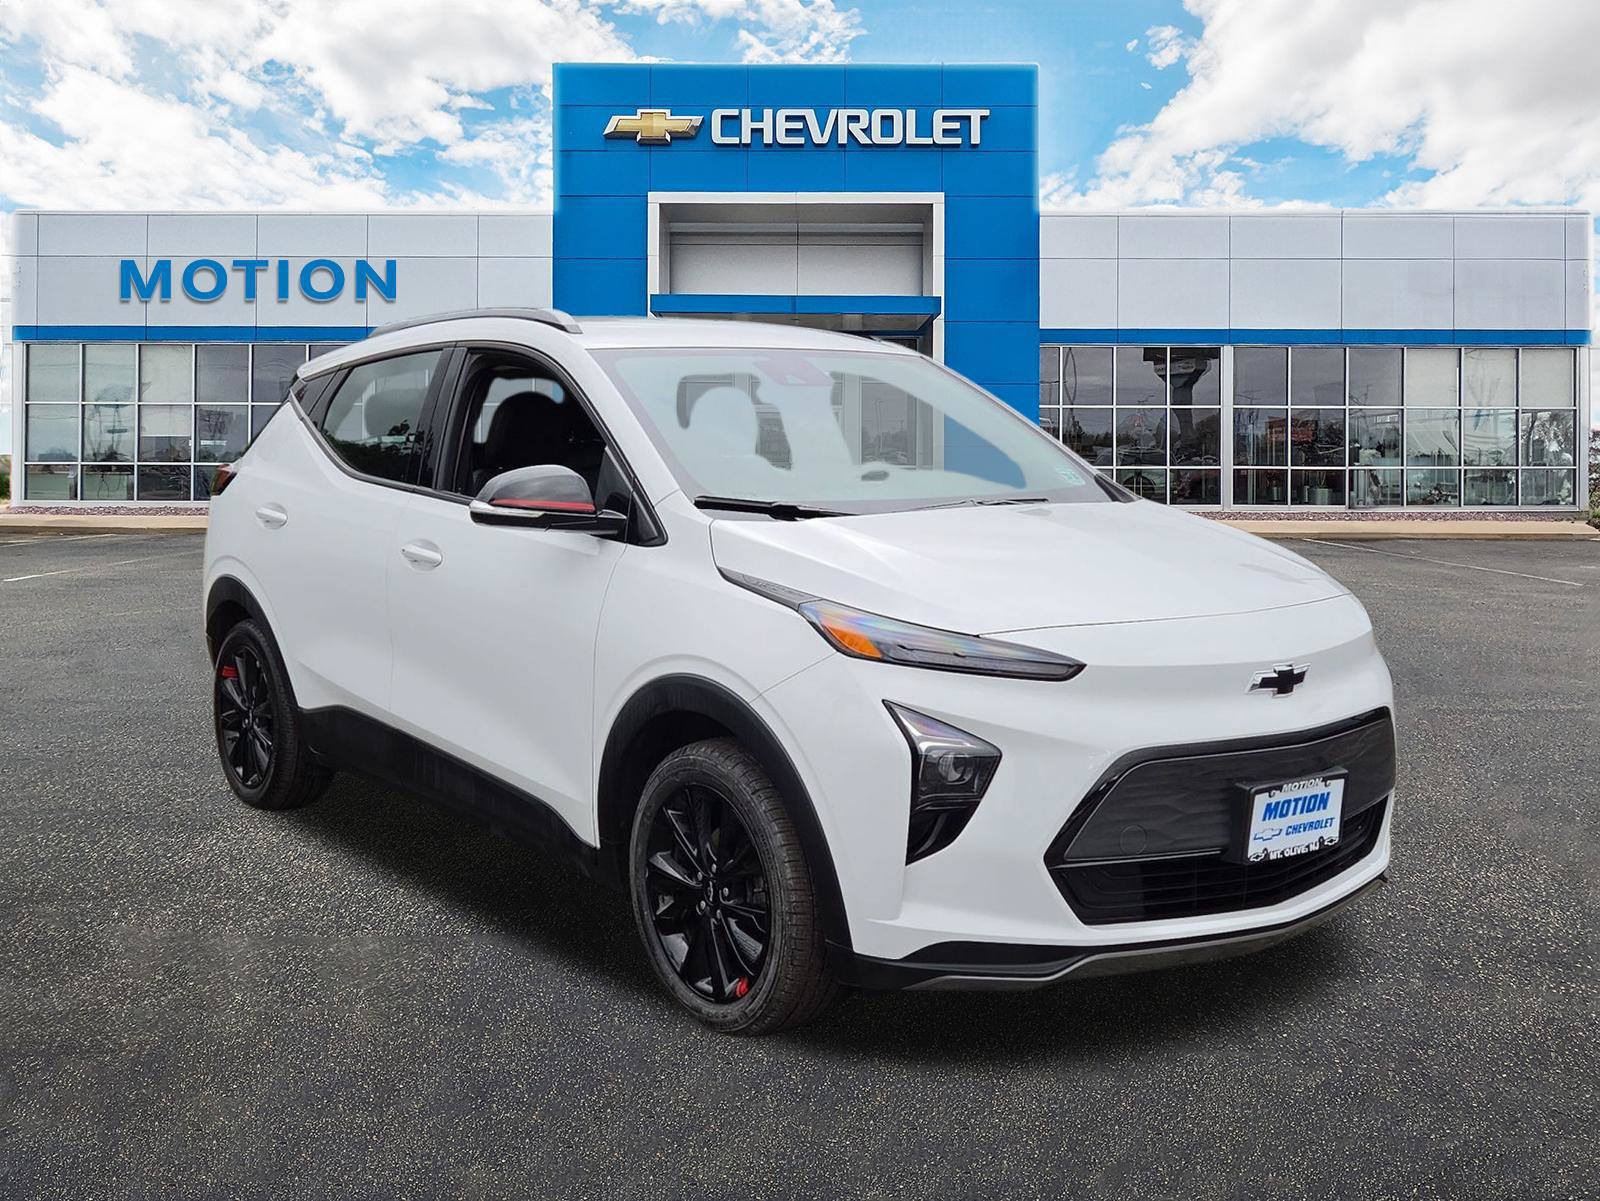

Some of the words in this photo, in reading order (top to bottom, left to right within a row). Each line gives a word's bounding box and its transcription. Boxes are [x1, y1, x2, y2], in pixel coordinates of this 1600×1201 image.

[711, 108, 991, 144] CHEVROLET
[119, 259, 397, 302] MOTION
[1281, 778, 1322, 792] MOTION
[1262, 792, 1330, 821] MOTION
[1285, 817, 1335, 836] CHEVROLET
[1310, 840, 1319, 852] NJ
